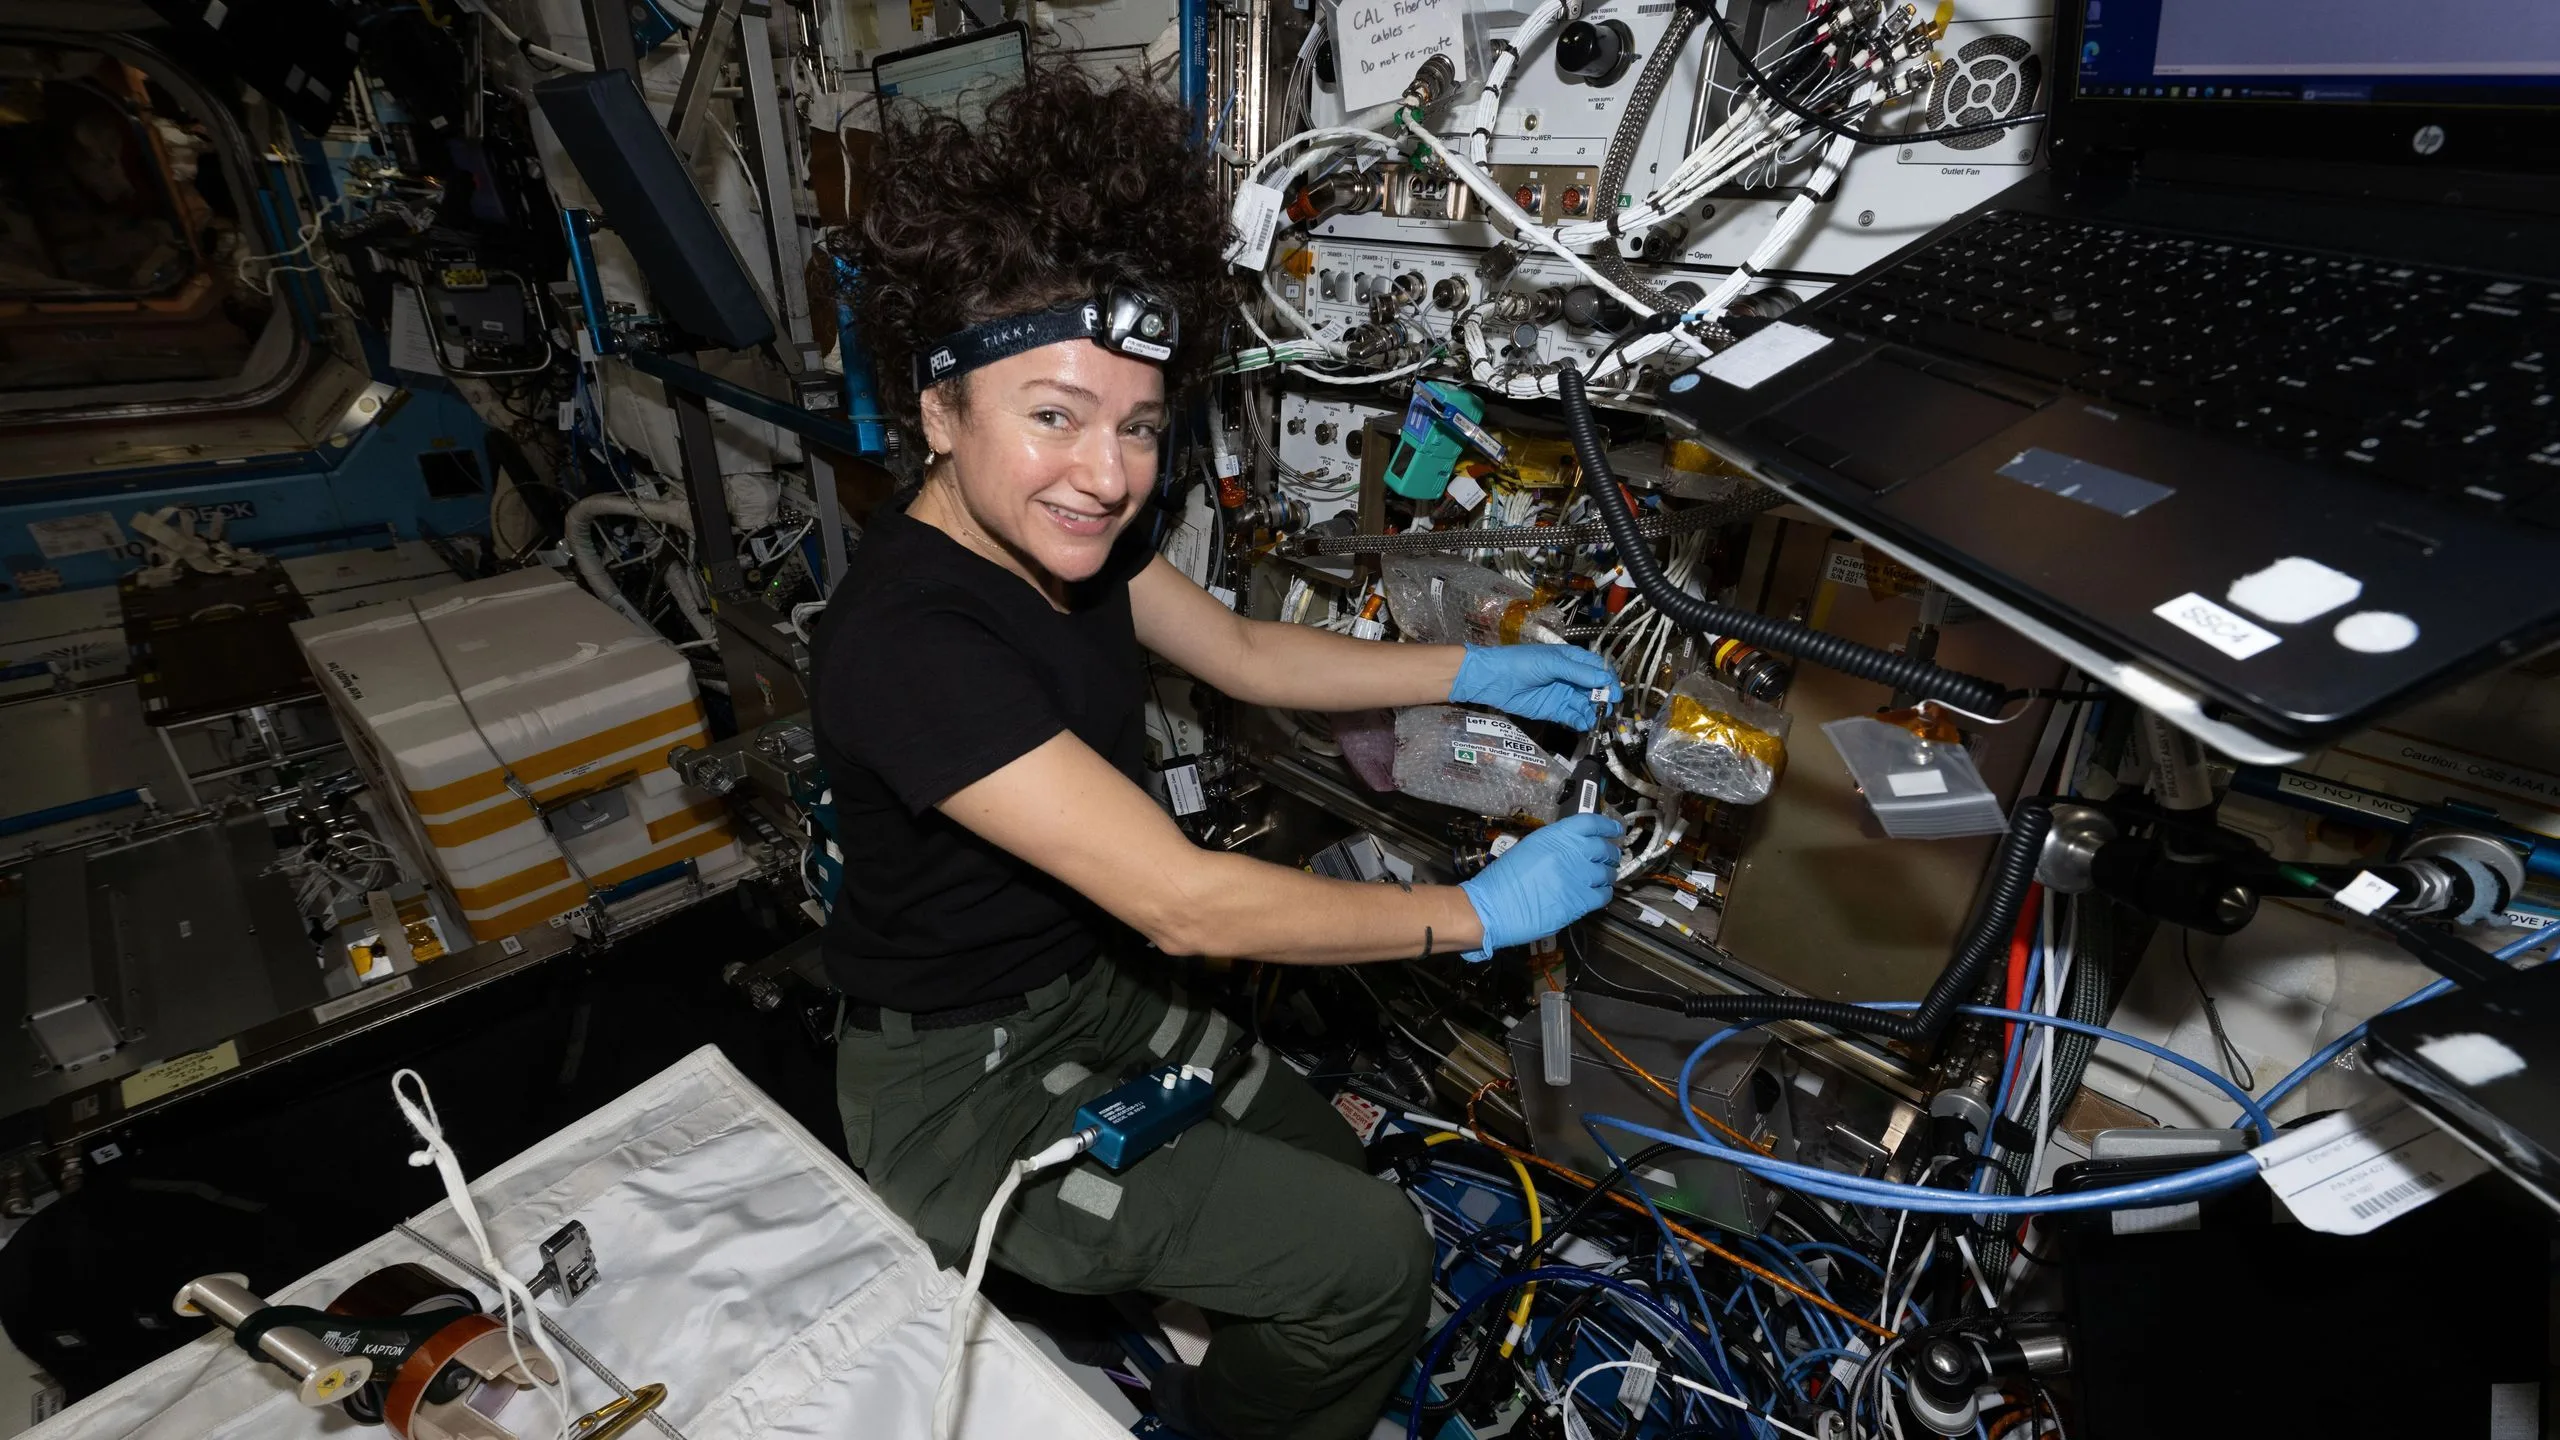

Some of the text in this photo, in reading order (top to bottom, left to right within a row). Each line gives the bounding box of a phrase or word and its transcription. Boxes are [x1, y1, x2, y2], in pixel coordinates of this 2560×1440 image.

[1353, 8, 1384, 30] CAL
[1393, 0, 1421, 17] Fiber
[1371, 24, 1403, 44] cables
[1361, 36, 1453, 74] Do not re-route
[1530, 147, 1539, 155] J2
[1577, 147, 1585, 155] J3
[1941, 167, 1980, 176] Outlet Fan
[1694, 251, 1712, 260] Open
[983, 323, 1036, 348] TIKKA
[931, 349, 956, 378] PETZL
[1832, 566, 1845, 575] P/N
[1834, 555, 1879, 574] Science
[1831, 573, 1858, 584] S/N 001
[2182, 605, 2250, 642] SSC4
[1467, 717, 1486, 726] Left
[1491, 721, 1512, 730] CO2
[1453, 741, 1545, 764] Contents Under Pressure
[1505, 740, 1533, 752] KEEP
[2401, 746, 2460, 772] Caution:
[2467, 764, 2507, 782] OGS
[2508, 776, 2545, 794] AAA
[2288, 778, 2420, 817] DO NOT MOV
[1341, 1102, 1352, 1115] FIRE
[1352, 1111, 1368, 1125] PORT
[362, 1344, 406, 1356] KAPTON
